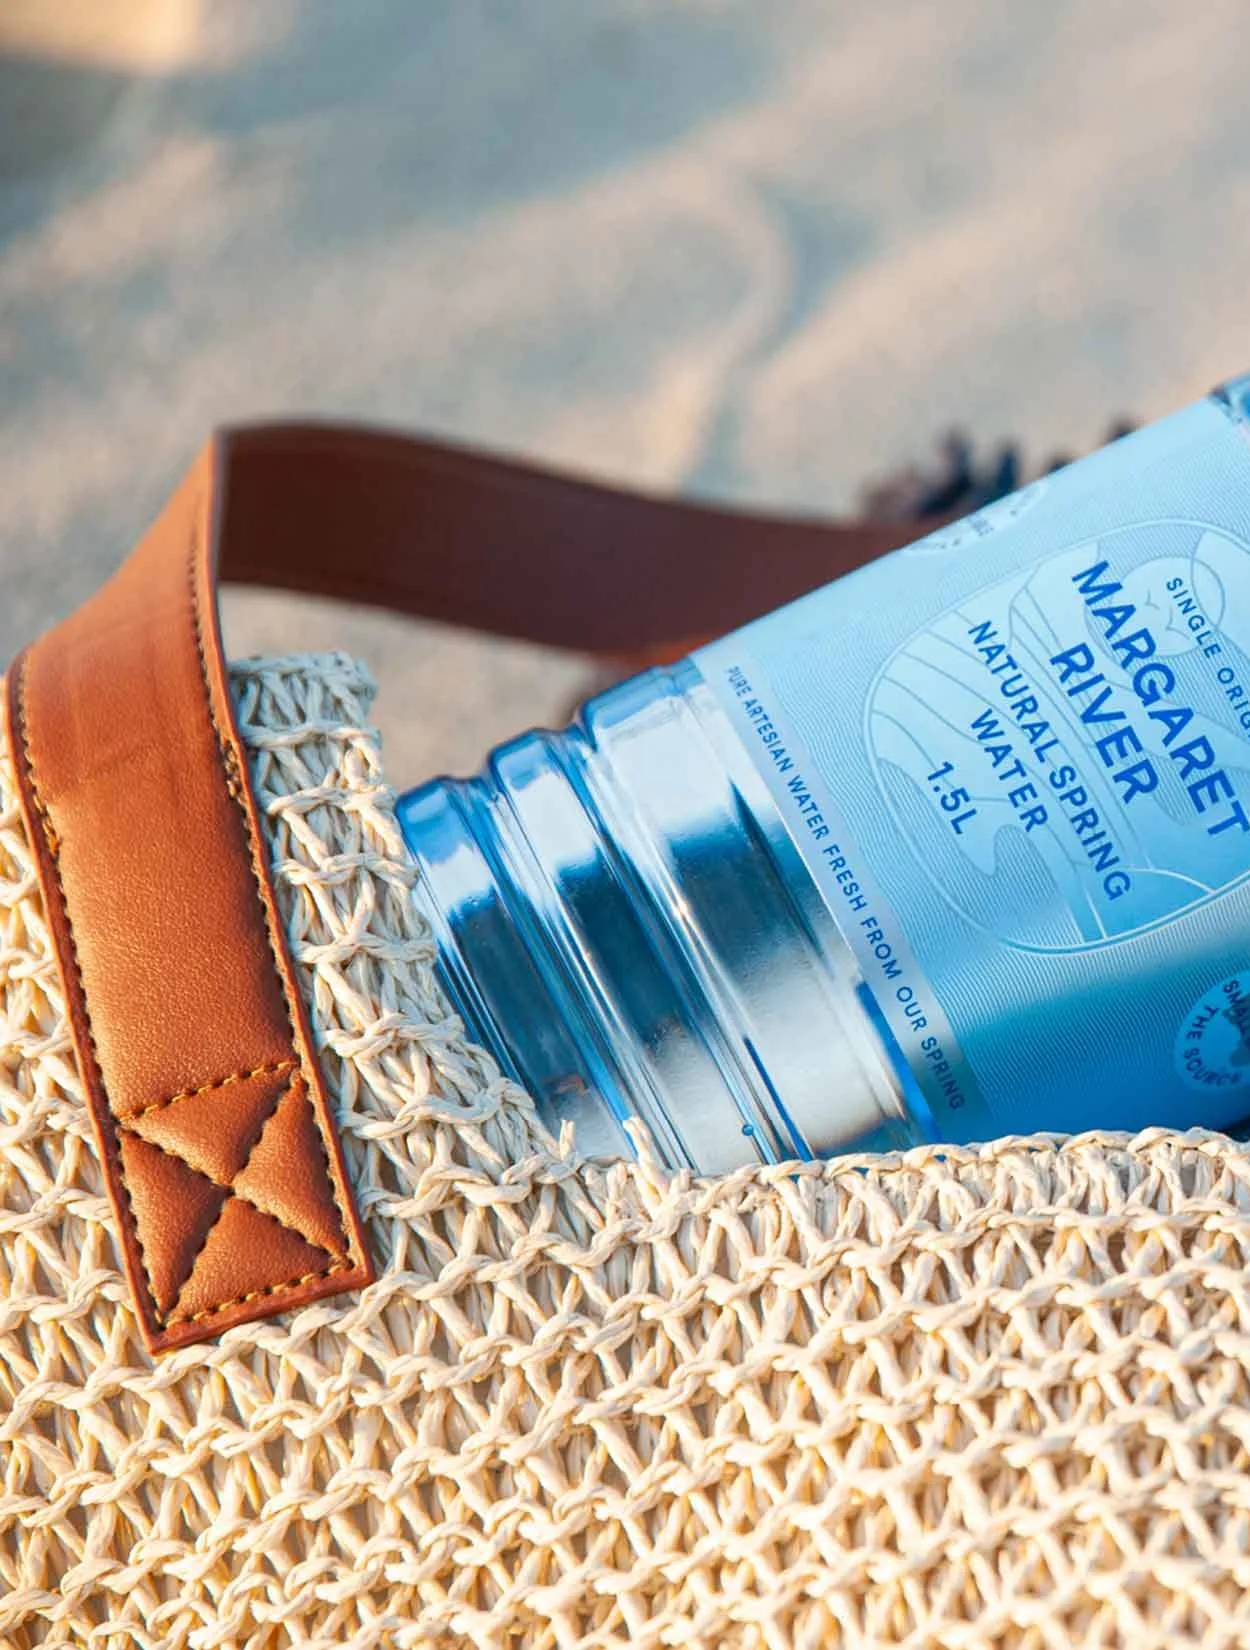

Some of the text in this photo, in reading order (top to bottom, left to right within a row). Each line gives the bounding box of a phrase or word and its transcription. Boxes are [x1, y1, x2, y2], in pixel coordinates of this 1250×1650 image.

[1166, 577, 1221, 659] SINGLE
[968, 620, 1058, 763] NATURAL
[1049, 765, 1131, 901] SPRING
[1050, 642, 1158, 804] RIVER
[1072, 560, 1250, 835] MARGARET
[927, 761, 977, 835] 1.5L
[971, 708, 1048, 833] WATER
[727, 666, 966, 1110] PURE ARTESIAN WATER FRESH FROM OUR SPRING
[1186, 1005, 1219, 1040] THE
